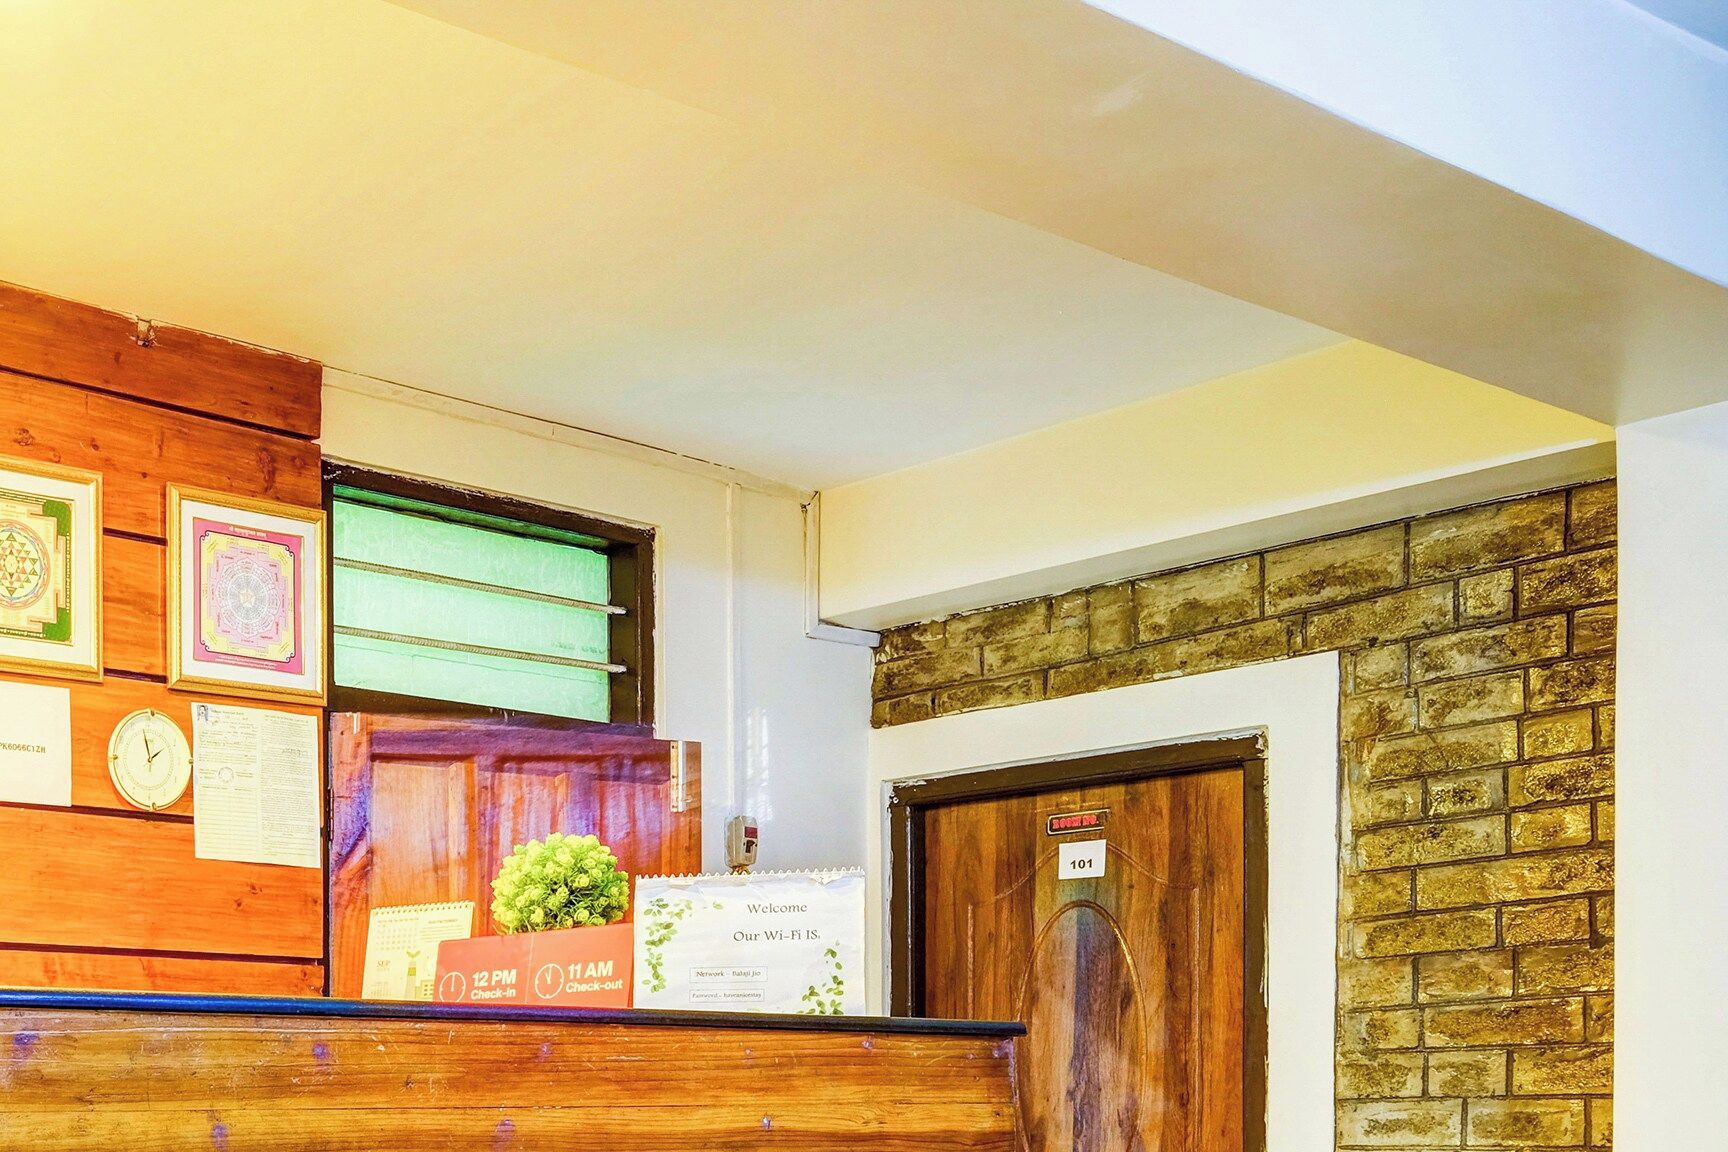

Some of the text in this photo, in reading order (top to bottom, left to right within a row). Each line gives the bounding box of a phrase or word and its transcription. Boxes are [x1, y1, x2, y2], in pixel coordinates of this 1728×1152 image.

[1070, 858, 1093, 870] 101
[747, 903, 808, 914] Welcome
[733, 931, 760, 942] Our
[764, 930, 802, 941] Wi-Fi
[567, 960, 614, 979] 11 AM
[696, 970, 725, 978] Network
[472, 968, 517, 987] 12 PM
[565, 978, 624, 993] Check-out
[471, 986, 517, 1000] Check-in
